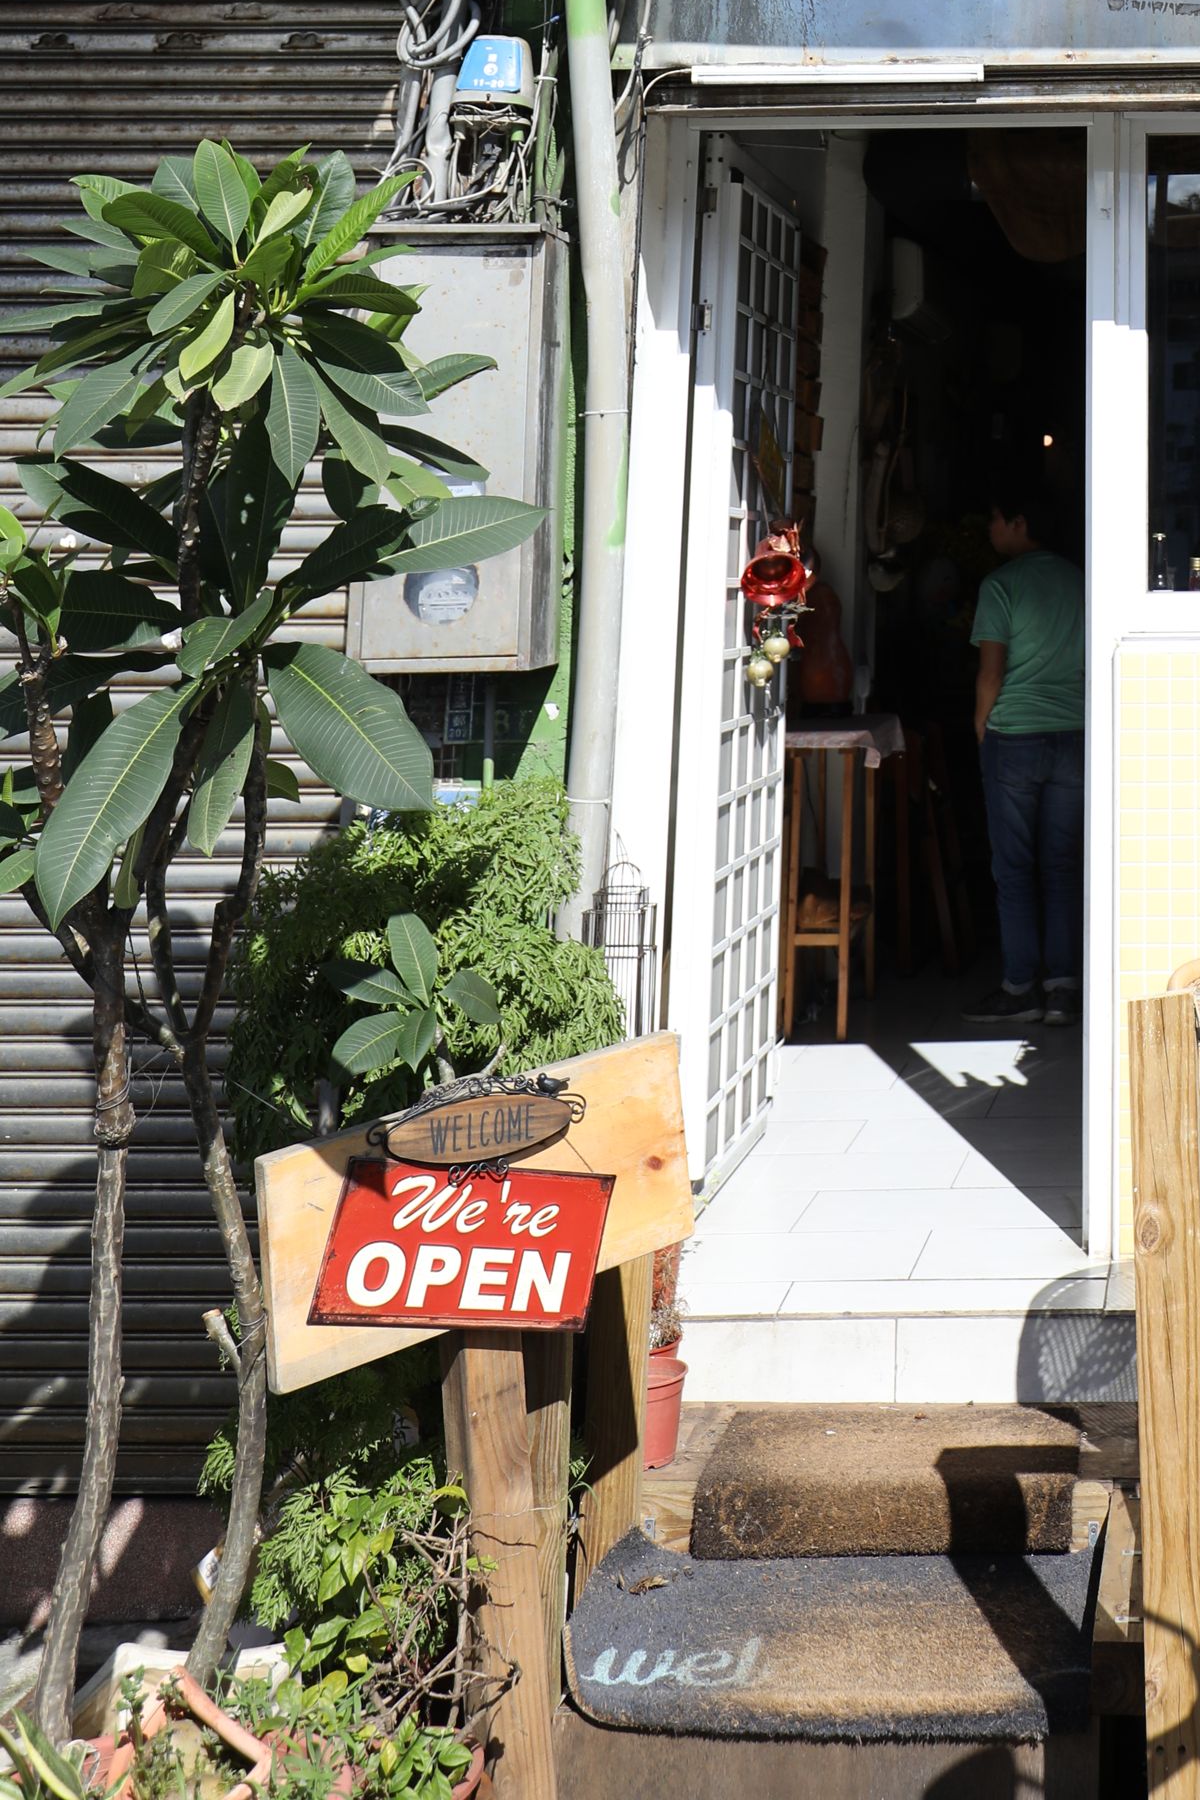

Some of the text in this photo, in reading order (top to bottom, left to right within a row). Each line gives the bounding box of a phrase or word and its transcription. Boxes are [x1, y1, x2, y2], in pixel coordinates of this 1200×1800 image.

[429, 1103, 536, 1155] WELCOME
[391, 1175, 561, 1238] We're
[345, 1241, 572, 1313] OPEN
